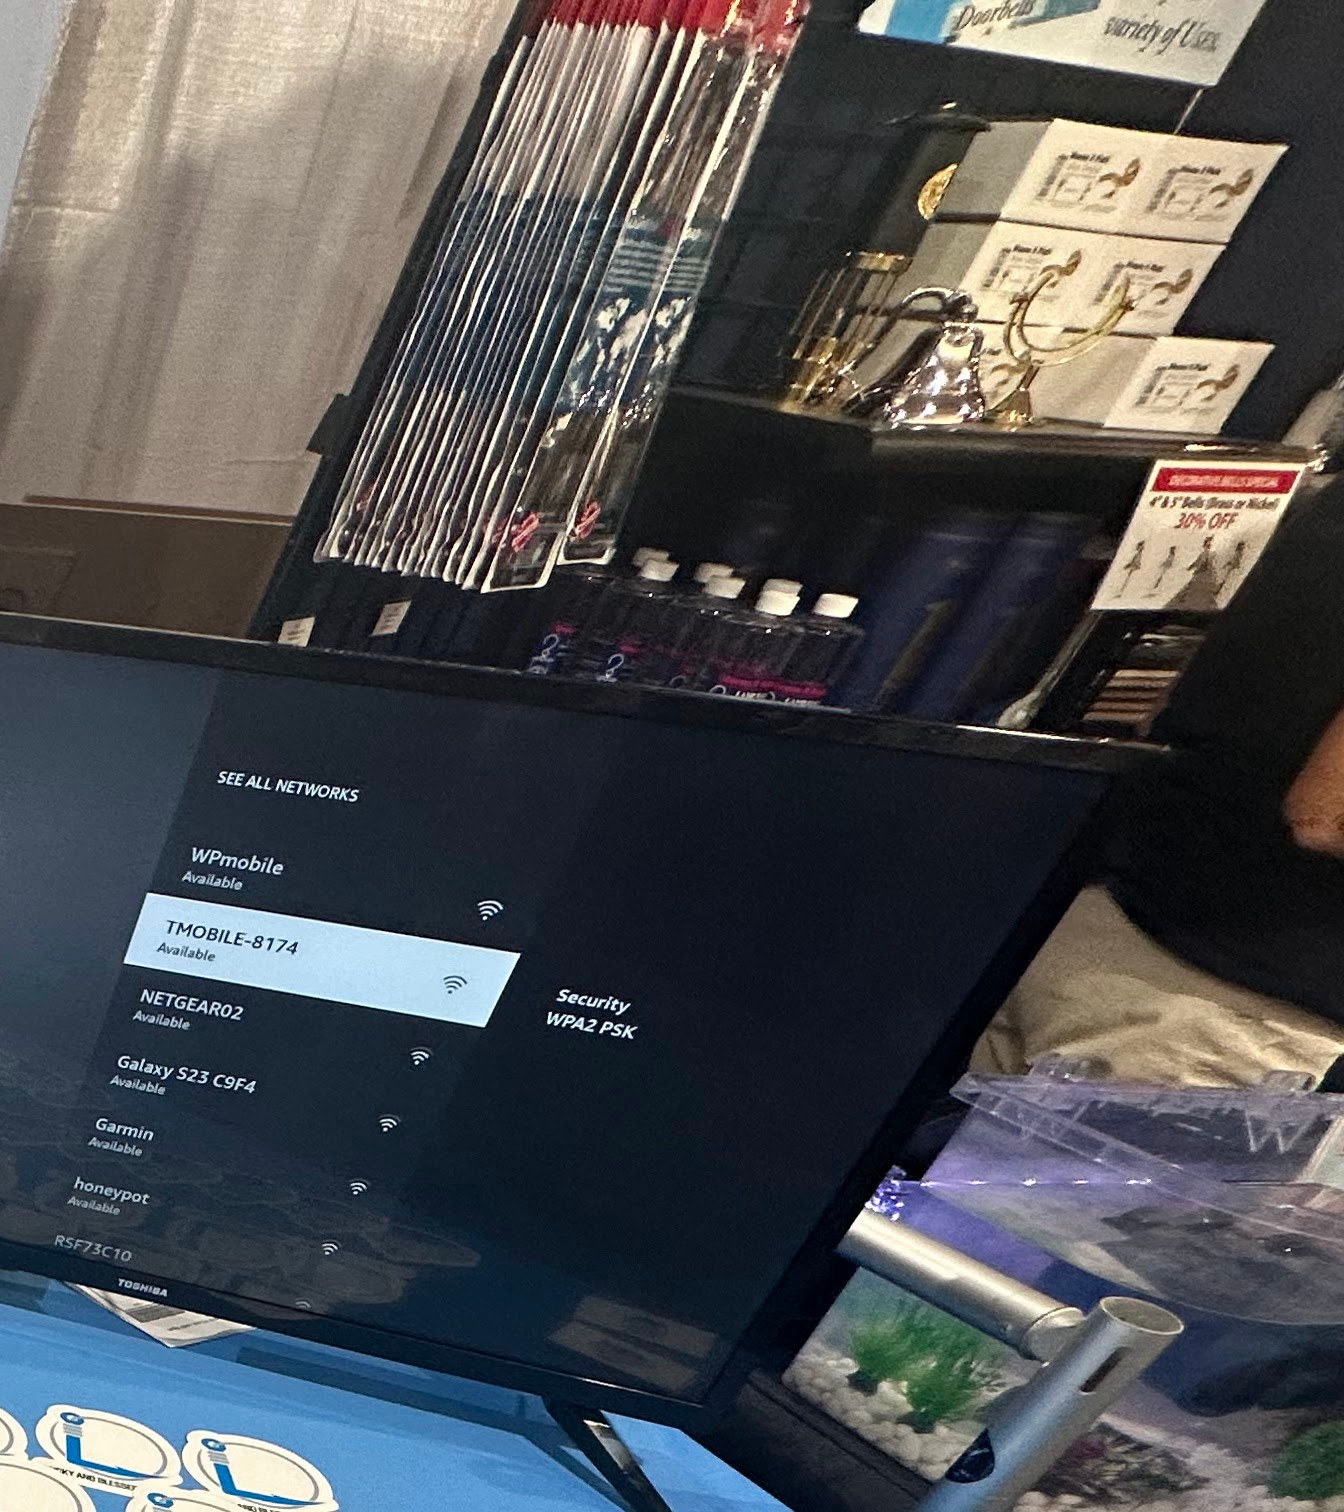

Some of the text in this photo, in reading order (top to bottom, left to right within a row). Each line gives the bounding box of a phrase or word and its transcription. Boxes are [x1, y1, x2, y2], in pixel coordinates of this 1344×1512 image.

[1104, 16, 1160, 52] variety
[1161, 22, 1181, 55] of
[1174, 513, 1239, 529] 30% OFF
[217, 770, 359, 802] SEE ALL NETWORKS
[190, 846, 284, 875] WPmobile
[182, 871, 244, 891] Available
[165, 919, 300, 956] TMOBILE-8174
[157, 942, 216, 963] Available
[140, 989, 244, 1022] NETGEAR02
[555, 987, 631, 1015] Security
[133, 1010, 190, 1032] Available
[545, 1011, 638, 1040] WPA2 PSK
[110, 1075, 166, 1097] Available
[116, 1055, 257, 1095] Galaxy S23 C9F4
[95, 1117, 154, 1142] Garmin
[88, 1136, 143, 1158] Available
[73, 1176, 150, 1206] honeypot
[67, 1196, 121, 1217] Available
[54, 1234, 133, 1262] RSF73C10
[117, 1279, 169, 1298] TOSHIBA
